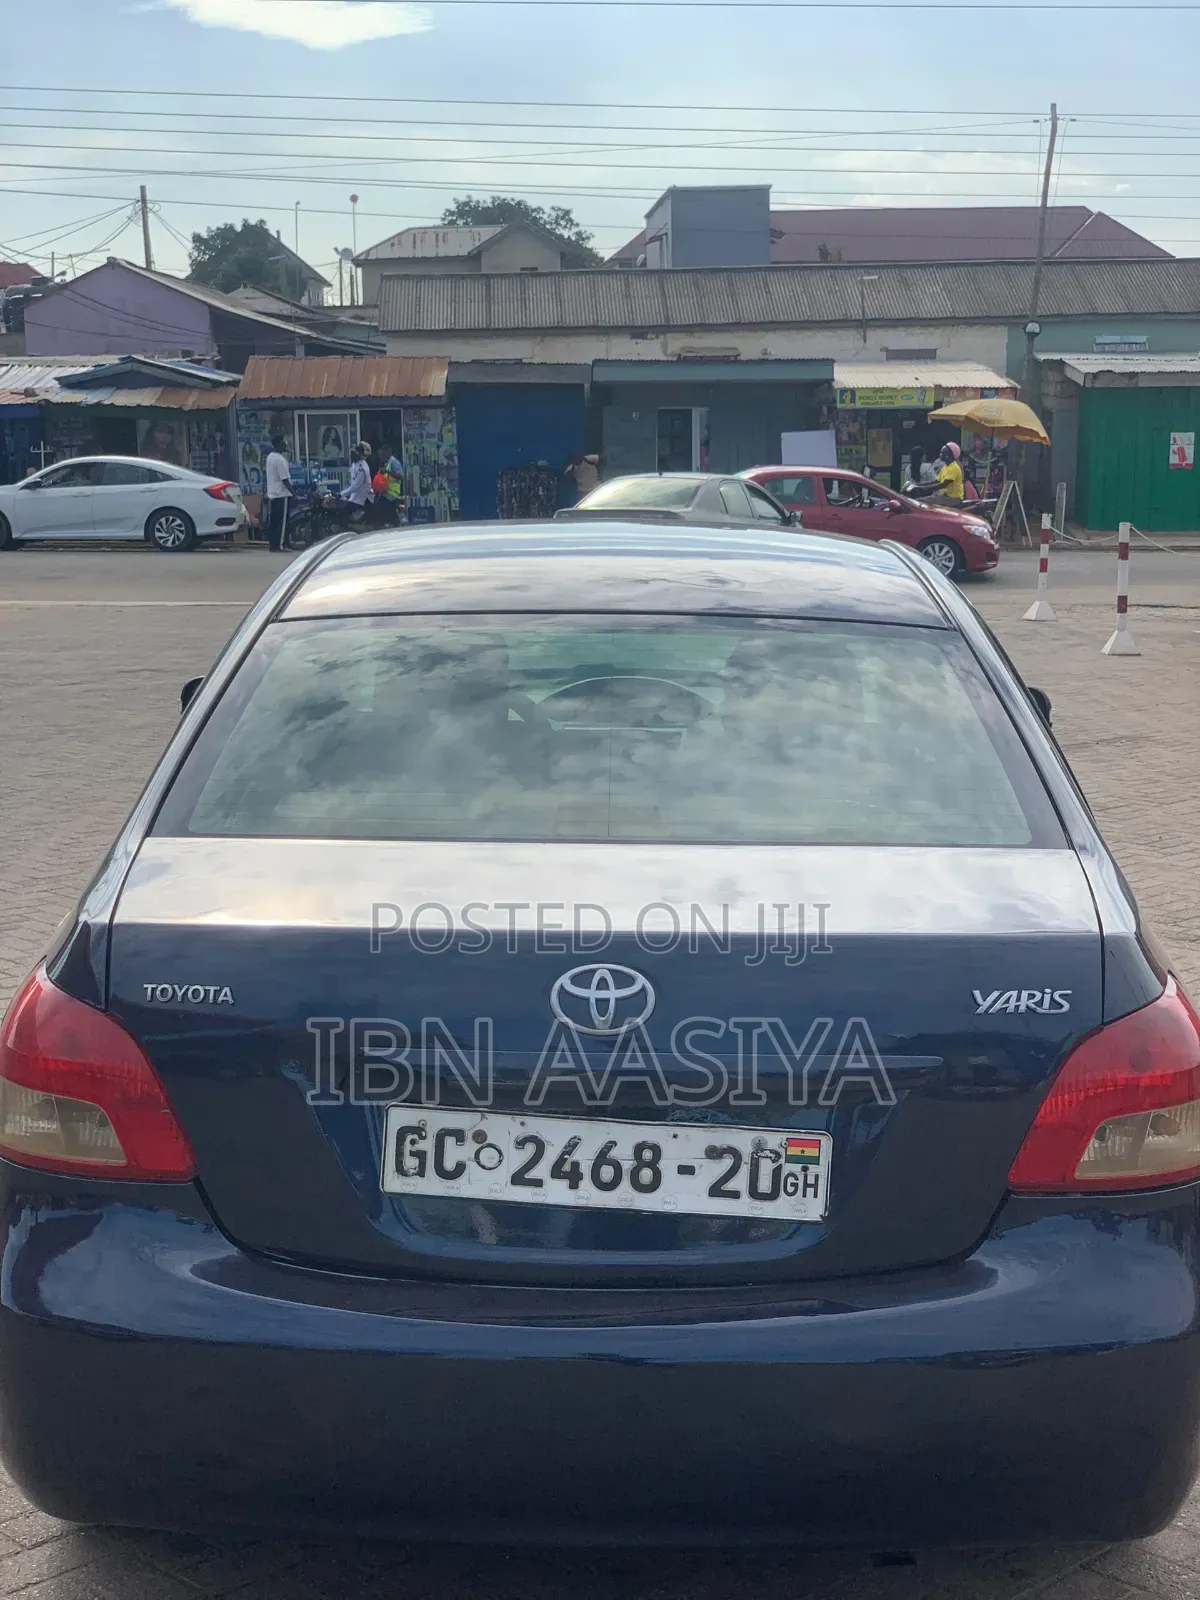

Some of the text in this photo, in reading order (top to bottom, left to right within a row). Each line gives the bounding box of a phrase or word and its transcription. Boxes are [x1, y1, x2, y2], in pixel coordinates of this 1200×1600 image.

[143, 983, 234, 1004] TOYOTA
[395, 1125, 467, 1181] GC
[783, 1170, 819, 1199] GH
